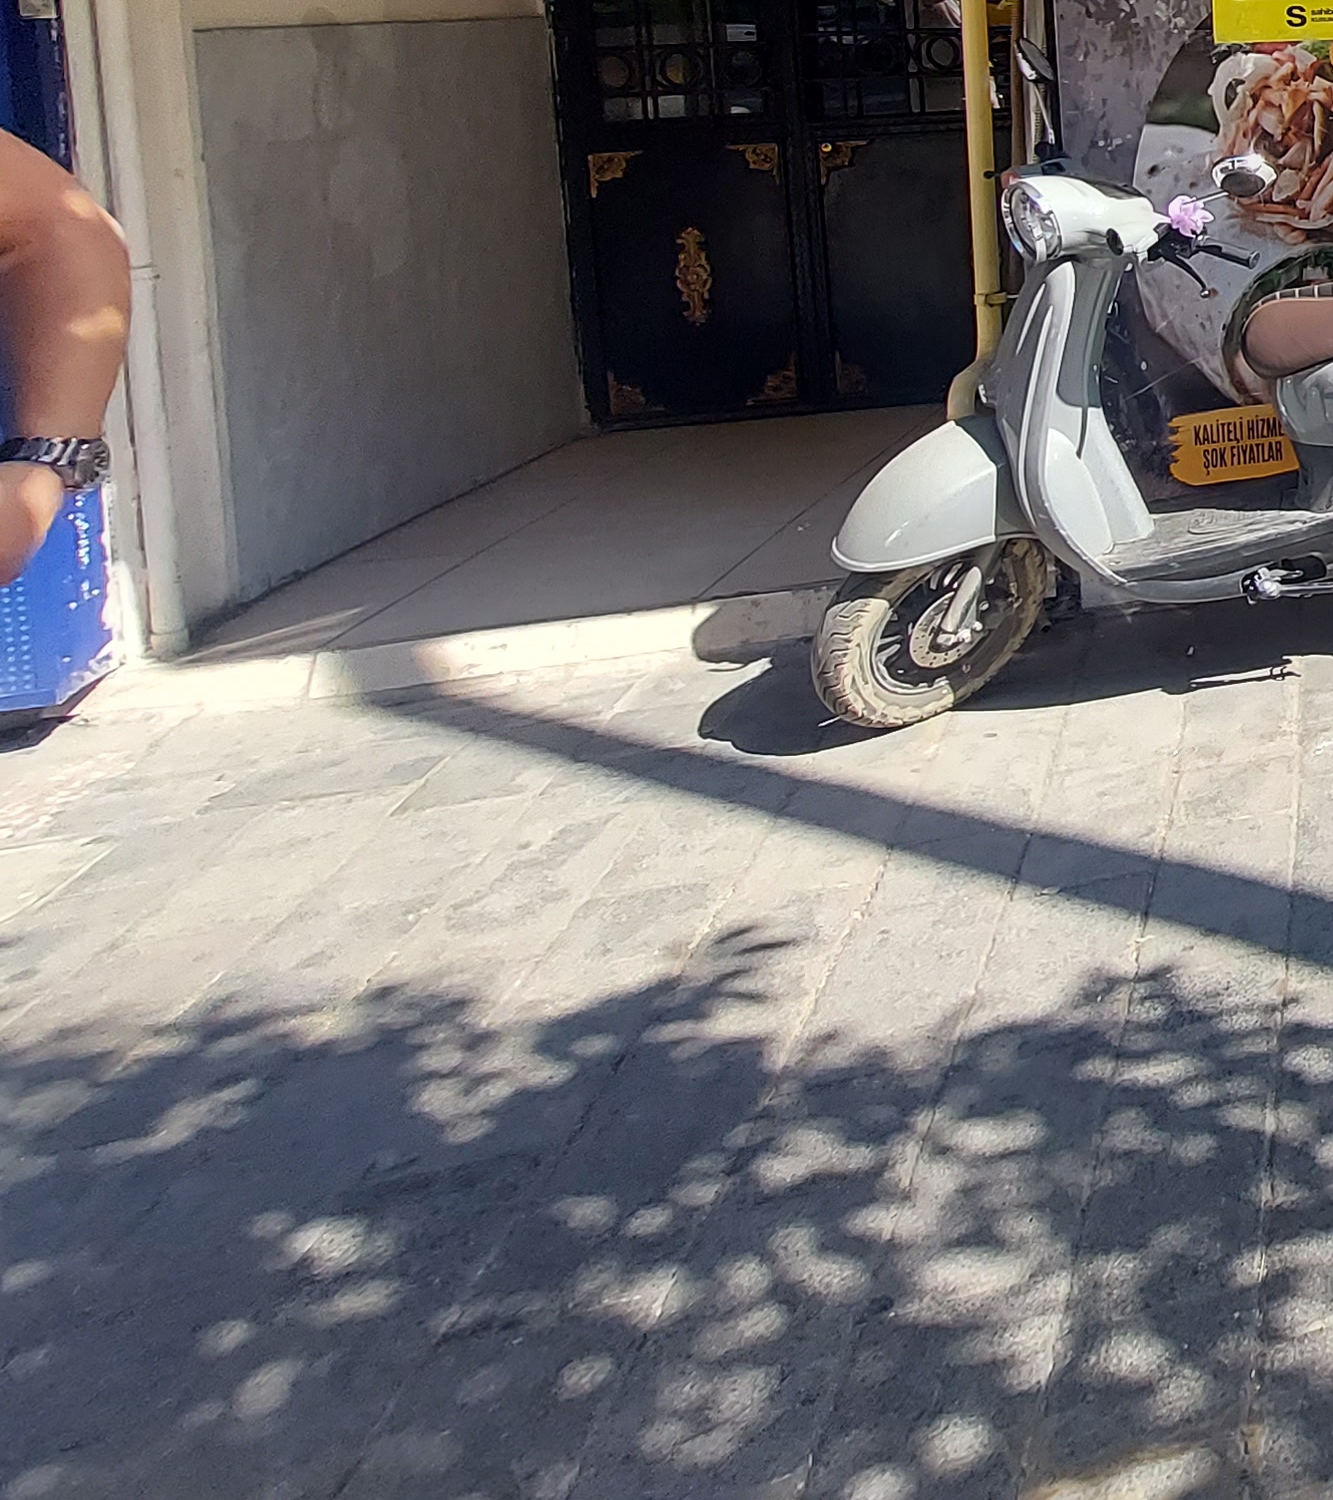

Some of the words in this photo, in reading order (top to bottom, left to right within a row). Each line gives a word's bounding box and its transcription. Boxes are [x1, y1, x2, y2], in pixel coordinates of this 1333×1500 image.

[1193, 416, 1244, 446] KALİTELİ
[1203, 447, 1228, 476] ŞOK
[1230, 441, 1283, 467] FİYATLAR
